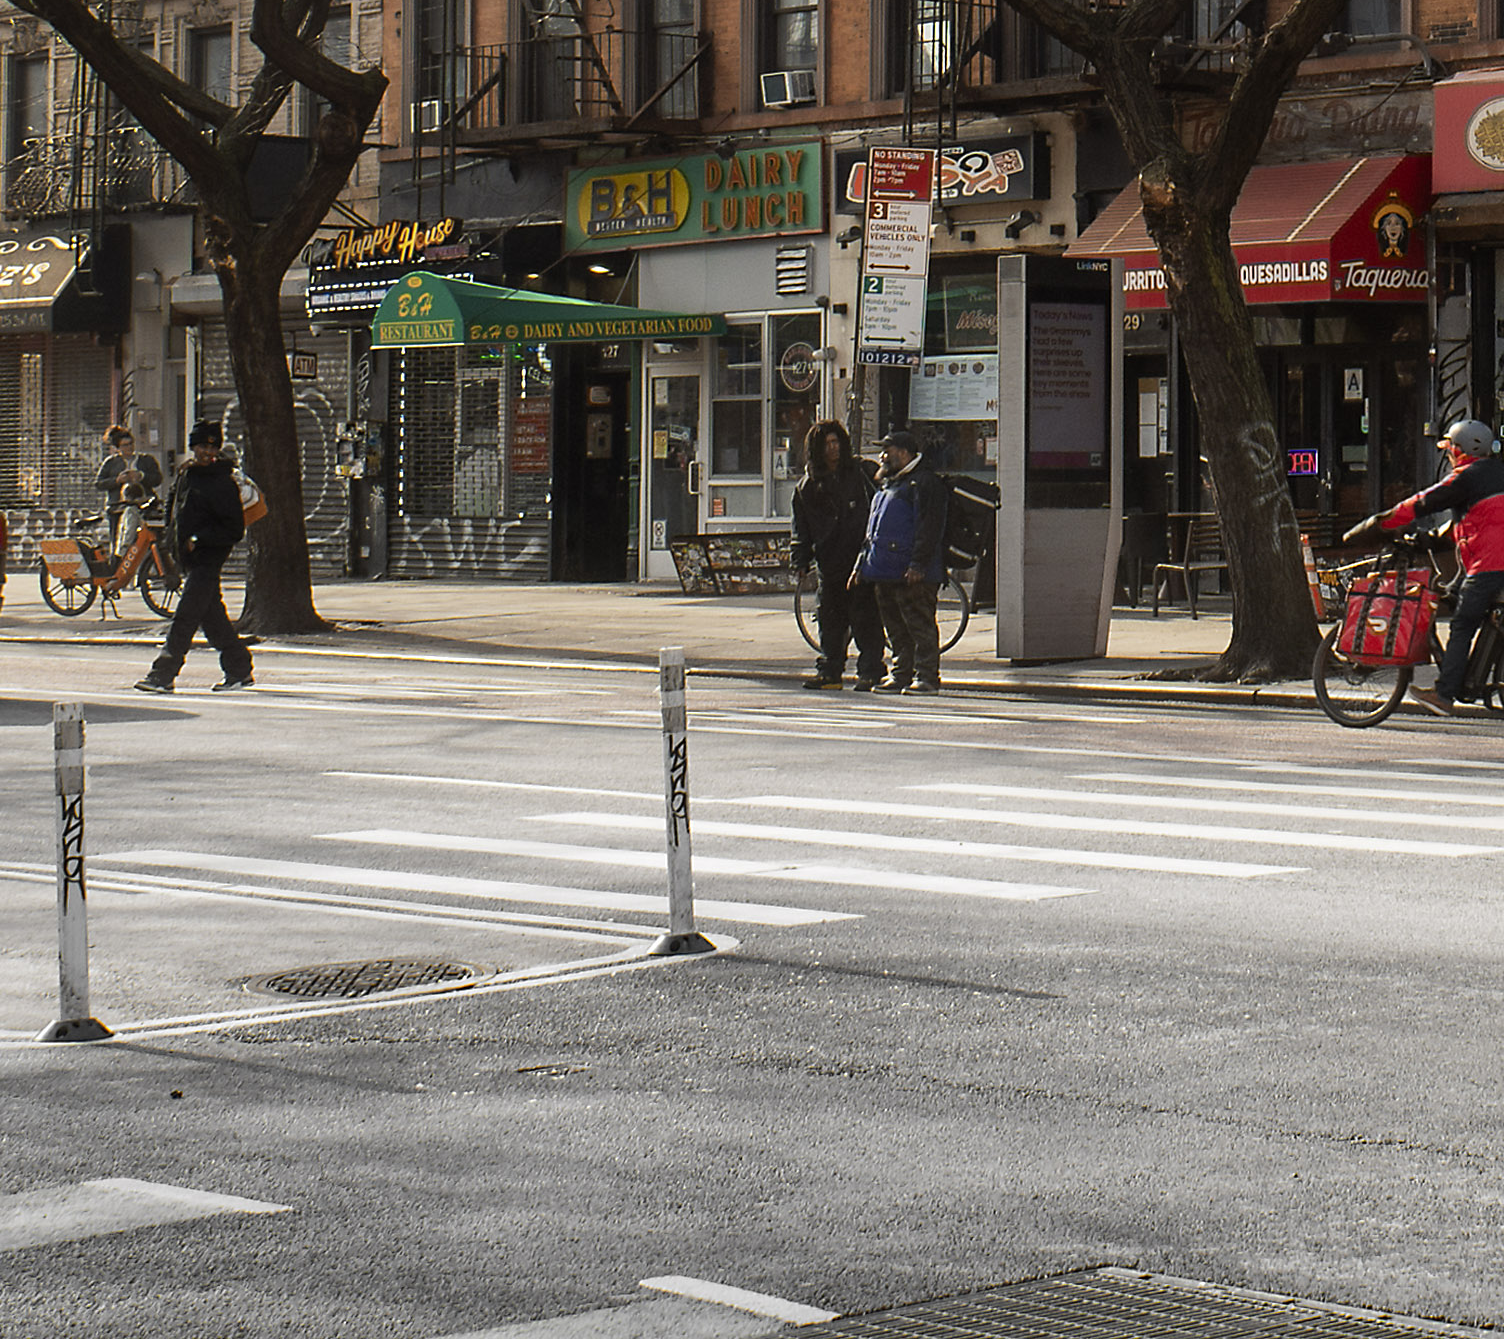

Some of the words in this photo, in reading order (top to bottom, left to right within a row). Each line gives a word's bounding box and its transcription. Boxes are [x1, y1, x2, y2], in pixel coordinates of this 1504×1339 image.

[874, 150, 887, 159] NO
[888, 151, 925, 161] STANDING
[704, 149, 805, 193] DAIRY
[874, 163, 897, 171] Monday
[901, 163, 920, 171] Friday
[701, 190, 805, 234] LUNCH
[873, 202, 884, 218] 3
[870, 224, 918, 233] COMMERCIAL
[336, 221, 401, 271] Happy
[398, 217, 456, 265] House
[870, 233, 906, 242] VEHICLES
[907, 234, 926, 243] ONLY
[868, 277, 878, 292] 2
[1122, 270, 1169, 292] URRITO
[1240, 261, 1328, 285] QUESADILLAS
[1341, 261, 1430, 297] Taqueria
[865, 315, 891, 324] Saturday
[1123, 315, 1141, 330] 29
[379, 322, 455, 341] RESTAURANT
[524, 323, 566, 340] DAIRY
[568, 321, 594, 338] AND
[595, 318, 677, 336] VEGETARIAN
[678, 316, 713, 333] FOOD
[295, 357, 315, 371] ATM
[860, 352, 905, 363] 101212
[1347, 373, 1360, 391] A
[121, 545, 139, 575] JOCO
